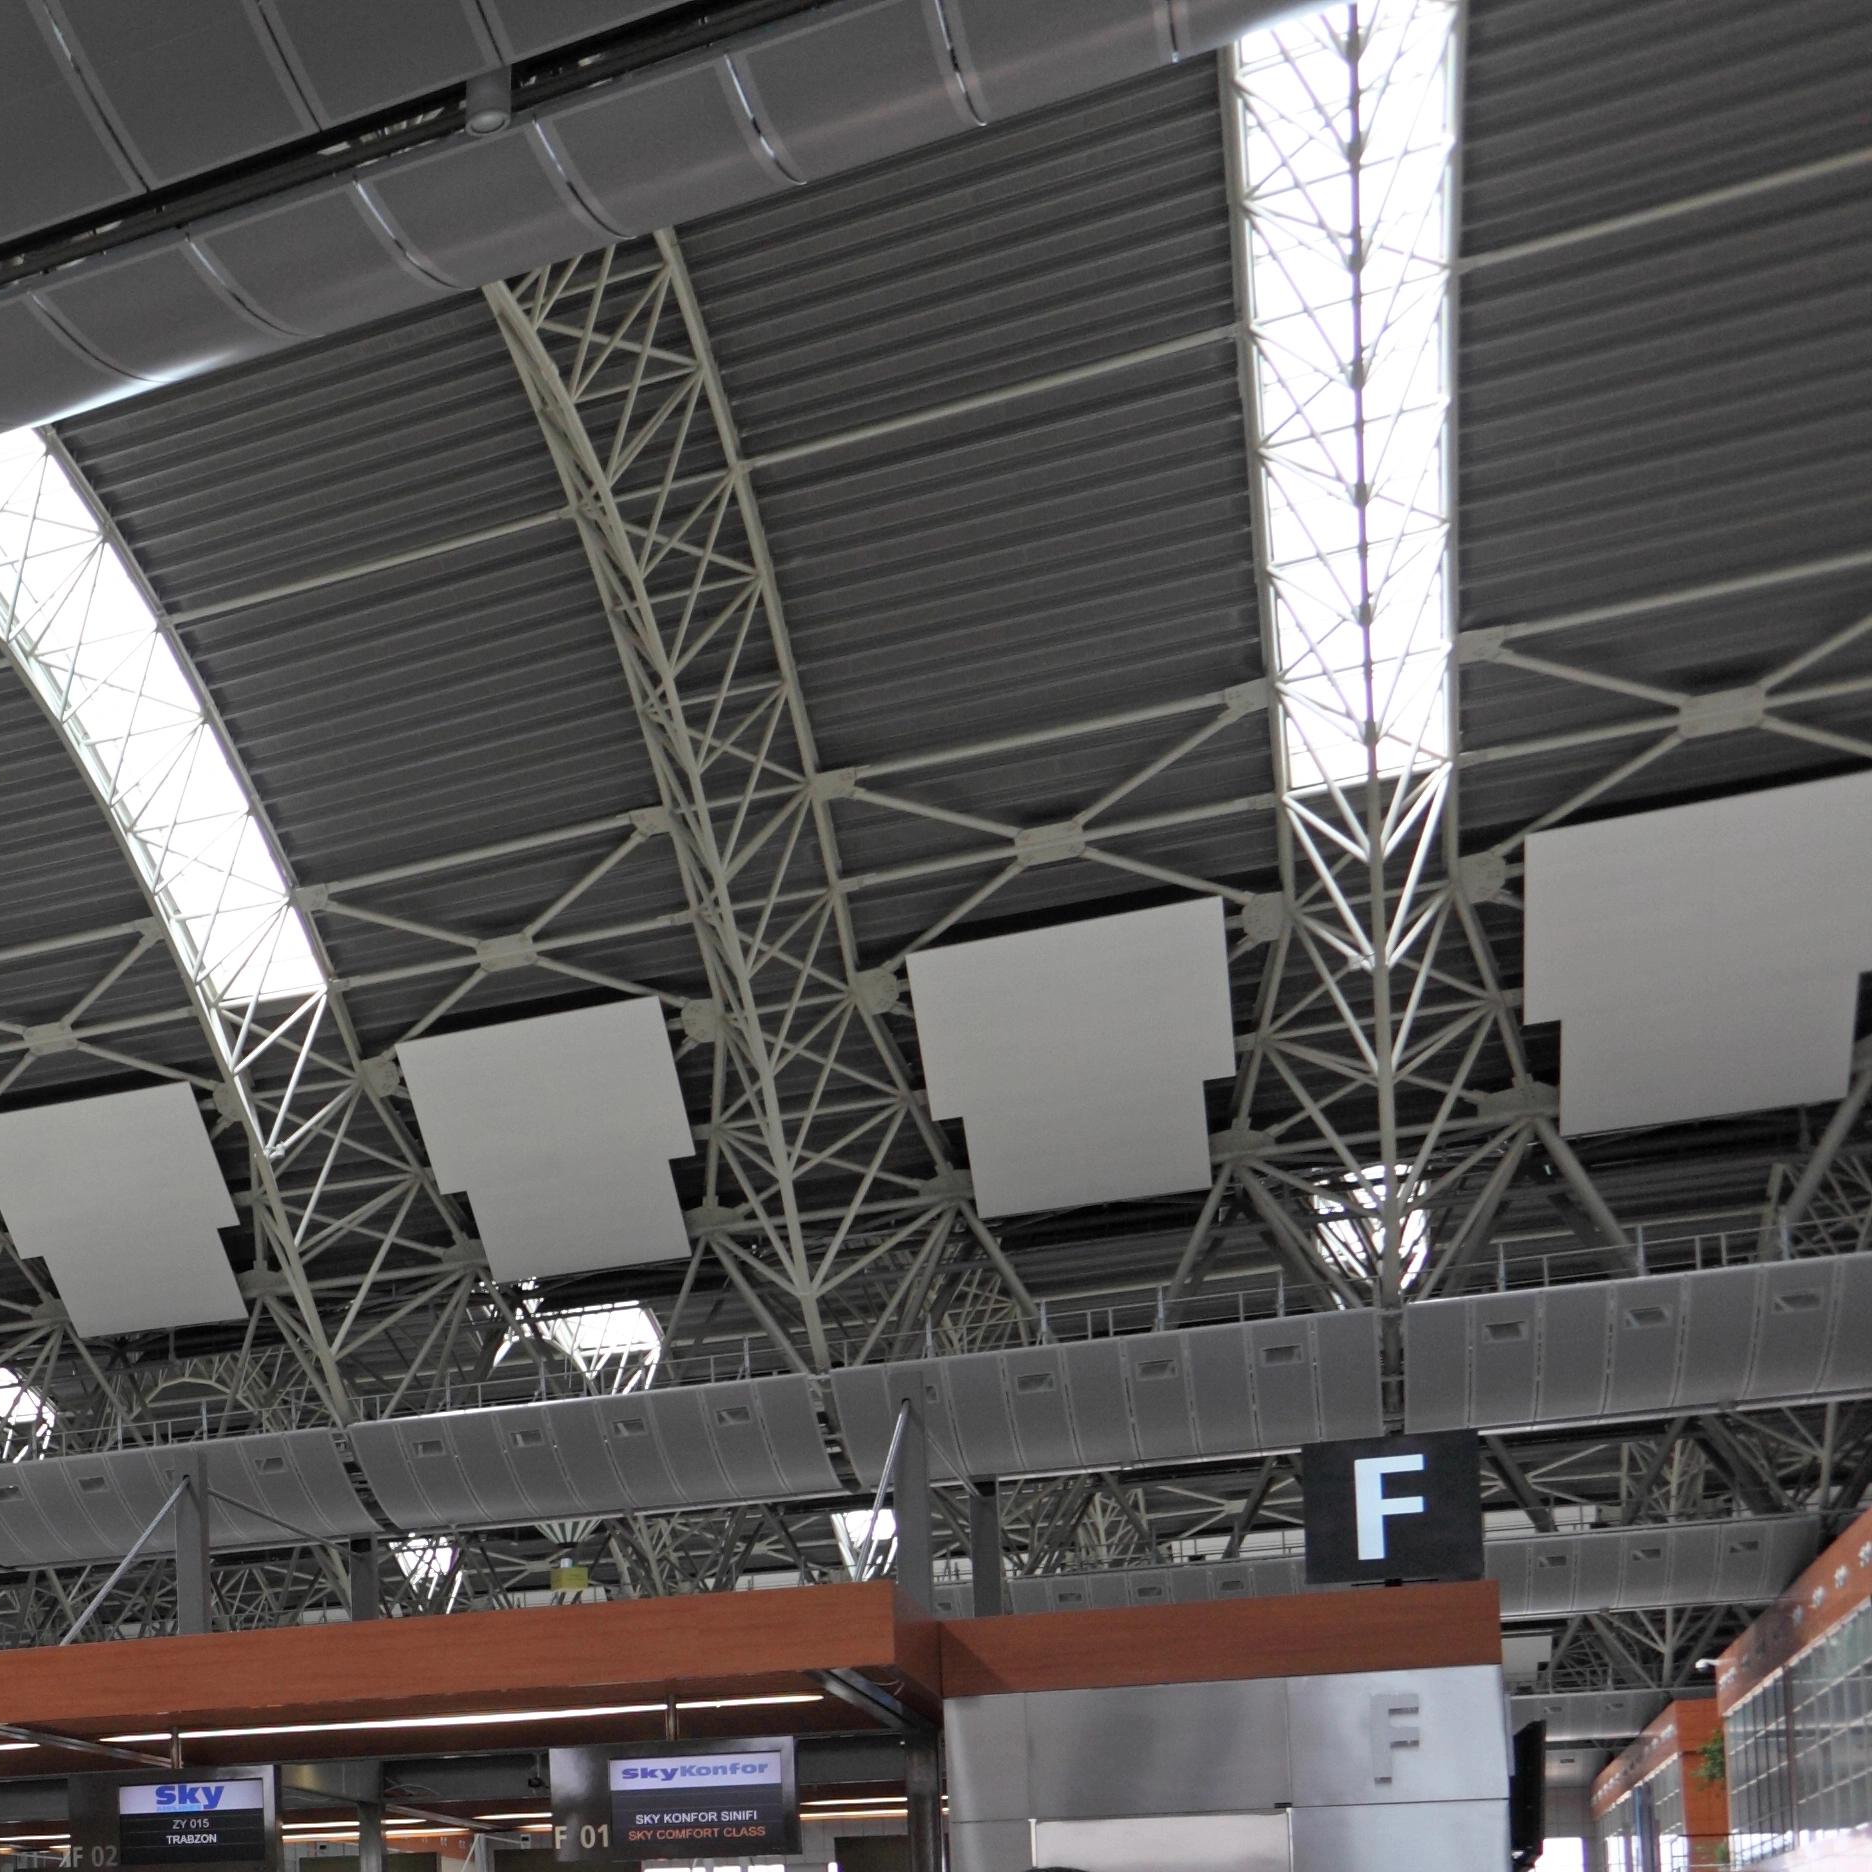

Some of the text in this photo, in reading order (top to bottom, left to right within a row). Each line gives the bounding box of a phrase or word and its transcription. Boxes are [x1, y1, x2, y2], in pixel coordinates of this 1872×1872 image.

[1354, 1454, 1424, 1560] F
[1369, 1693, 1419, 1784] F
[173, 1820, 187, 1829] ZY
[635, 1813, 661, 1825] SKY
[663, 1811, 718, 1824] KONFOR
[166, 1834, 217, 1844] TRABZON
[555, 1824, 609, 1849] F 01
[629, 1826, 766, 1841] SKY COMFORT CLASS
[73, 1845, 118, 1867] F 02
